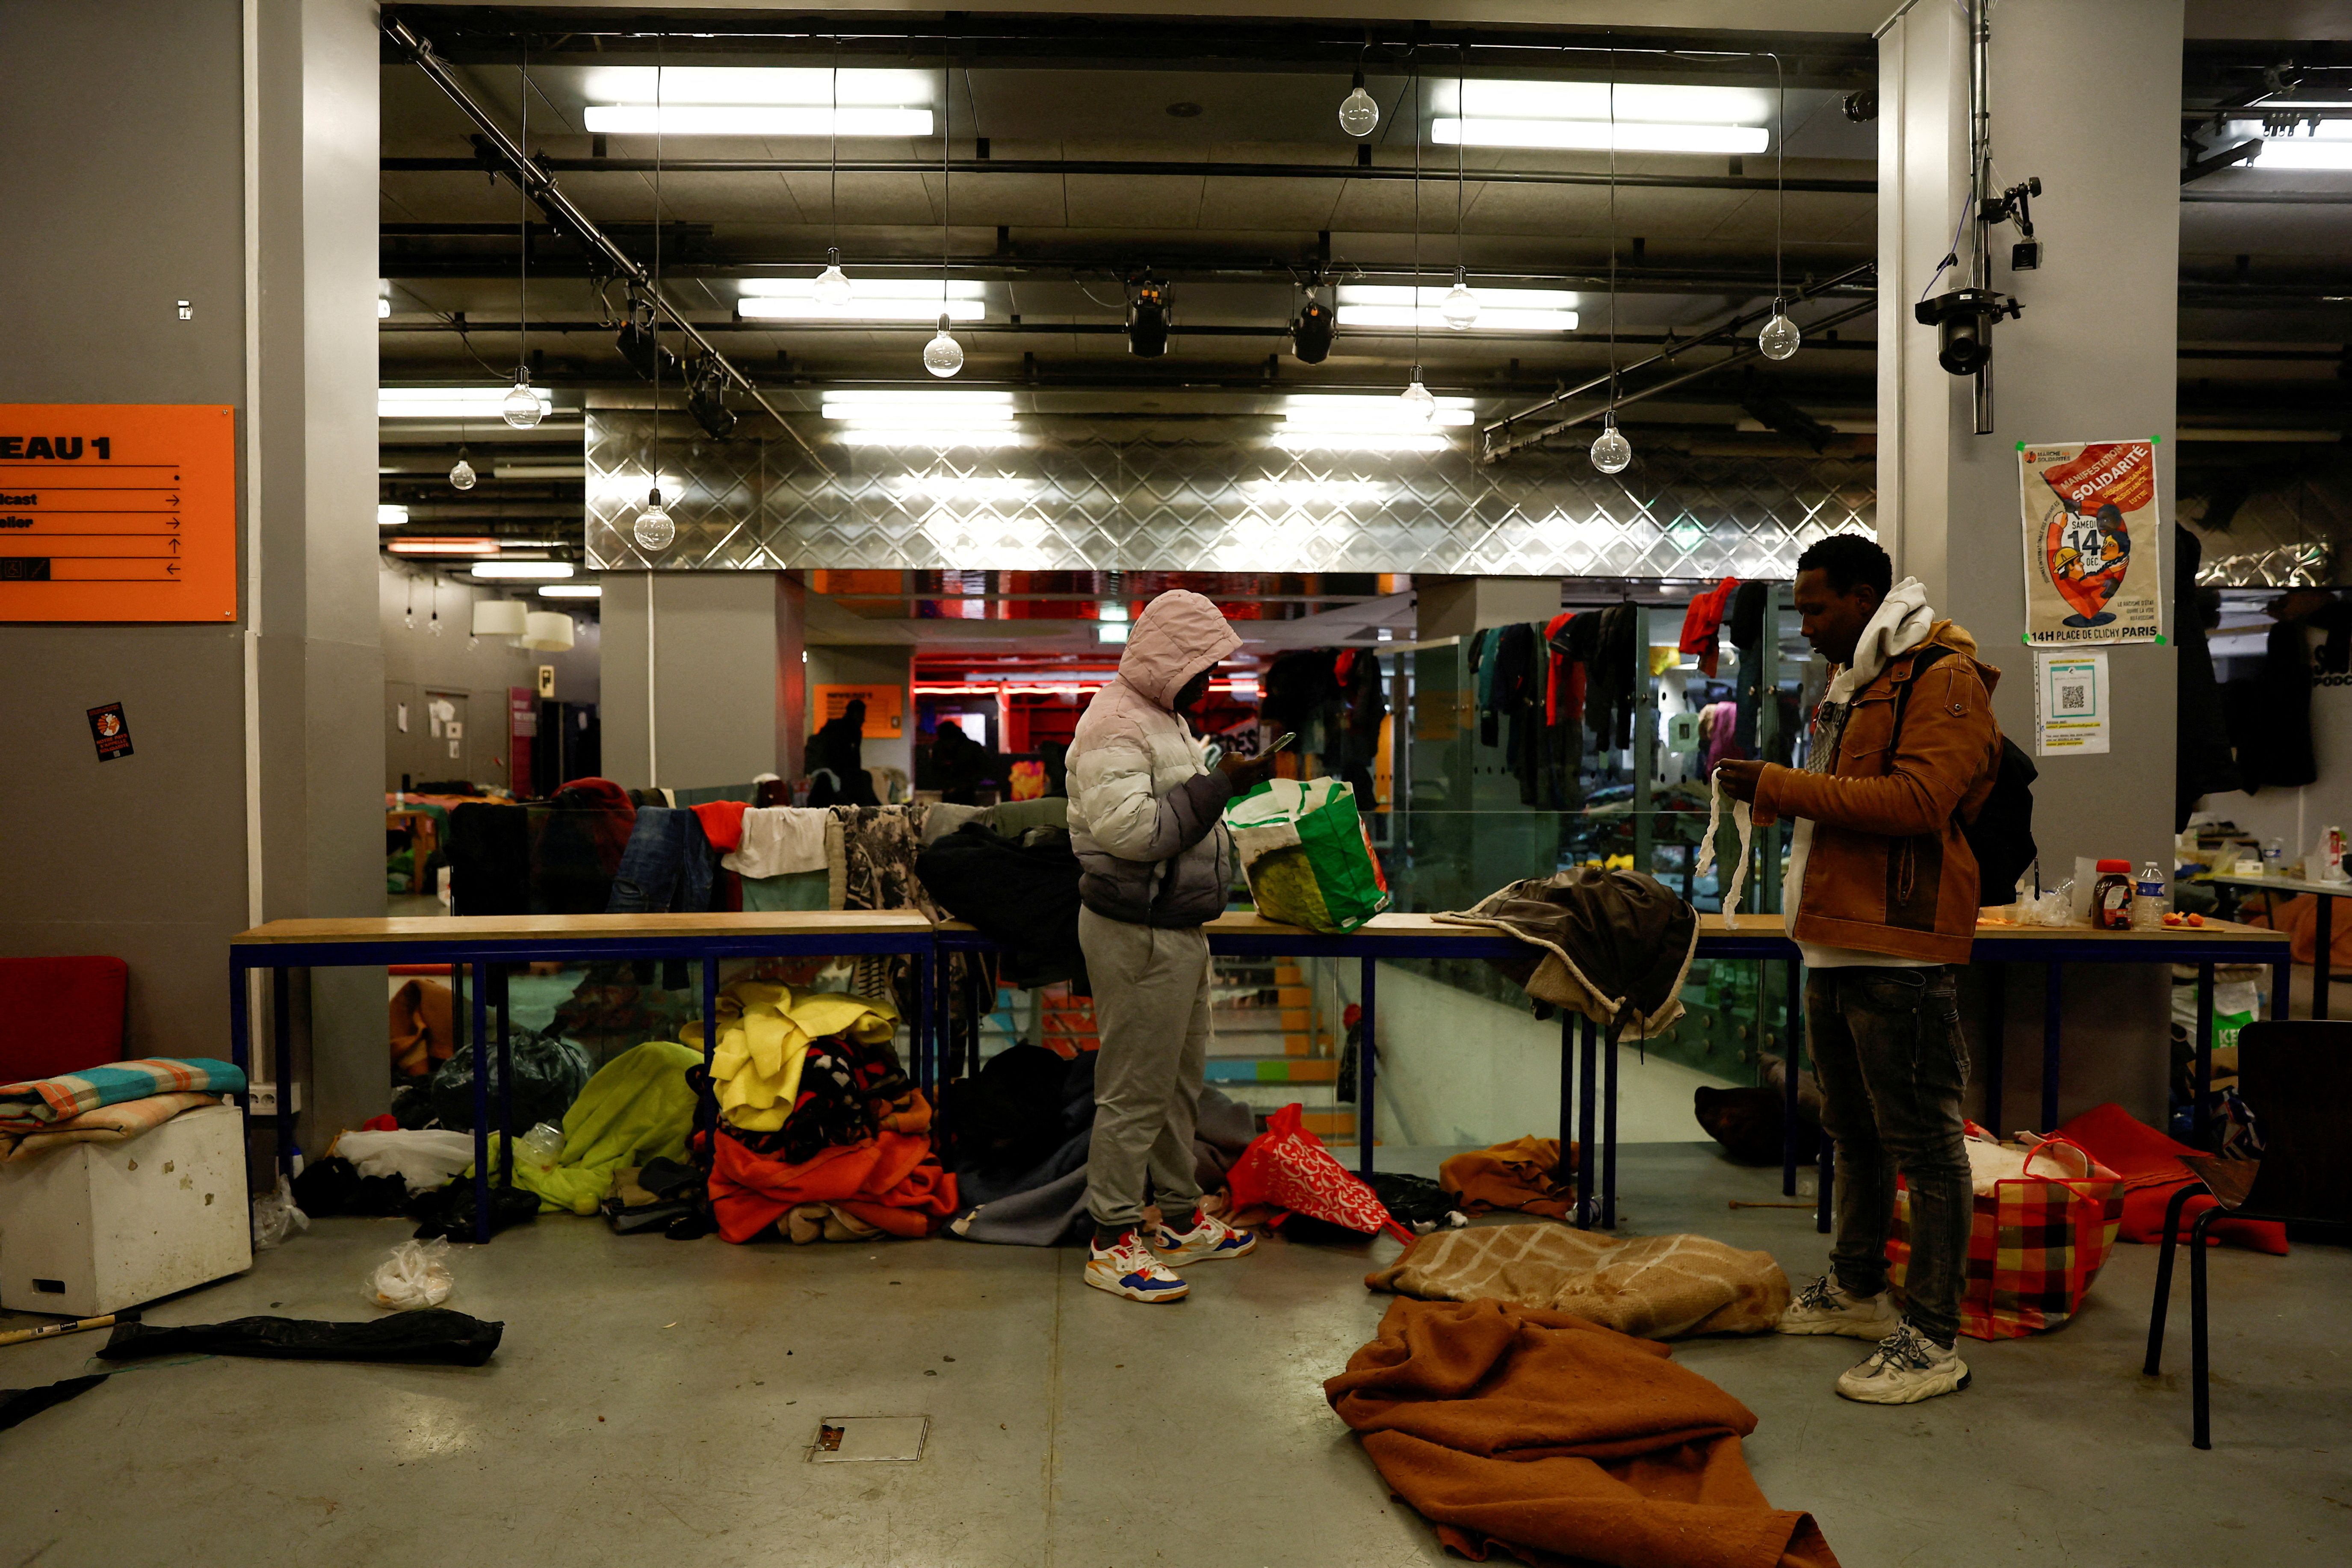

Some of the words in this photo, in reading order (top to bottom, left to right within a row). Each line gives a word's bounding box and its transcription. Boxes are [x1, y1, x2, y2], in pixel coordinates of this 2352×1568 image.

[91, 437, 110, 459] 1
[2059, 445, 2124, 490] MANIFESTATION
[2072, 444, 2148, 502] SOLIDARITÉ
[2128, 490, 2148, 505] LUTTE
[2072, 520, 2096, 529] SAMEDI
[2068, 530, 2101, 555] 14
[2032, 631, 2054, 641] 14H
[2056, 630, 2080, 640] PLACE
[2083, 629, 2092, 639] DE
[2094, 628, 2119, 638] CLICHY
[2122, 626, 2157, 637] PARIS
